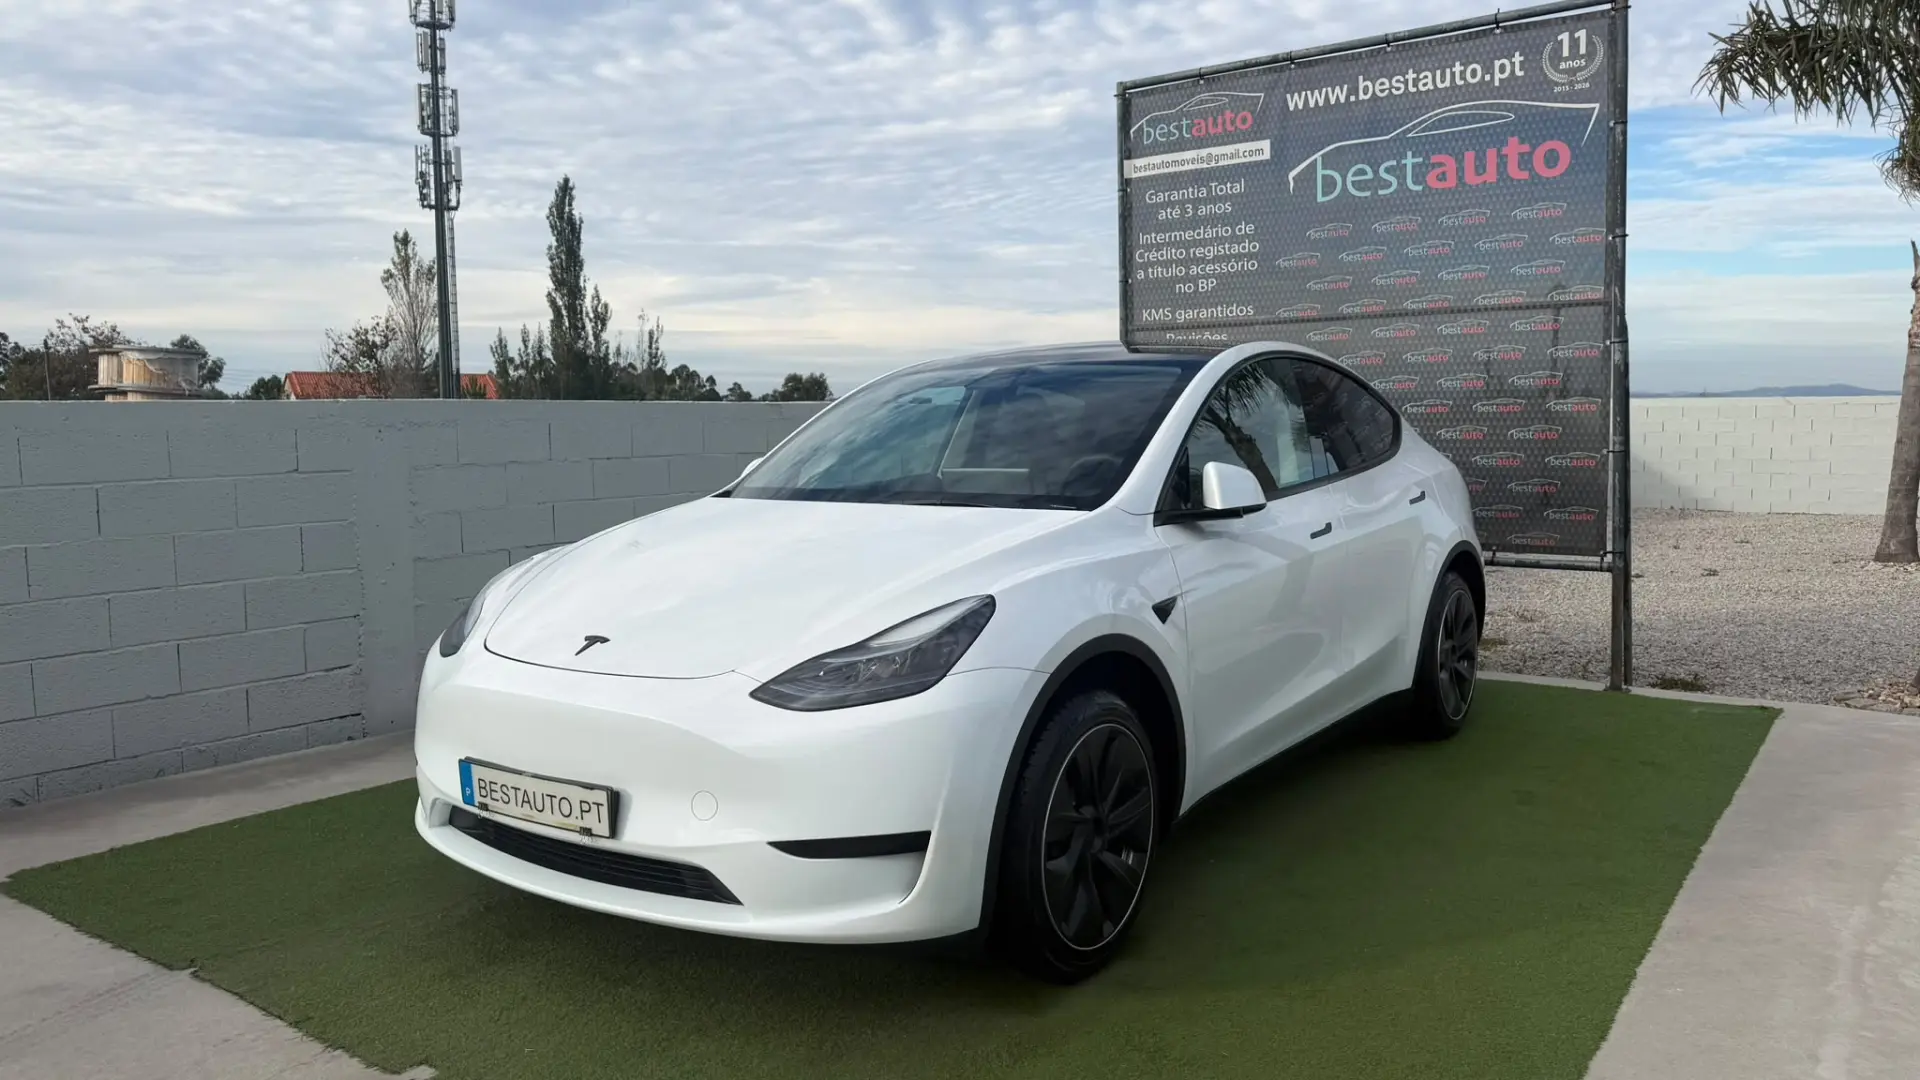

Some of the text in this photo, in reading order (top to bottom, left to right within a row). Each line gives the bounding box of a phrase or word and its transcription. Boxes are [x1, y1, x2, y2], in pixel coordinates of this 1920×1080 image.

[1557, 29, 1587, 57] 11
[1560, 59, 1586, 69] anos
[1286, 51, 1525, 111] www.bestauto.pt
[1143, 110, 1254, 144] bestauto
[1133, 146, 1264, 174] bestautomoveis@gmail.com
[1316, 136, 1572, 202] bestauto
[1145, 178, 1245, 204] Garantia Total
[1158, 202, 1232, 221] até 3 anos
[1516, 209, 1562, 219] bestauto
[1443, 216, 1486, 226] bestauto
[1376, 222, 1417, 233] bestauto
[1139, 221, 1255, 245] Intermedário de
[1310, 230, 1348, 239] bestauto
[1555, 234, 1602, 245] bestauto
[1480, 240, 1524, 250] bestauto
[1135, 240, 1260, 263] Crédito registado
[1409, 246, 1450, 256] bestauto
[1343, 252, 1382, 262] bestauto
[1280, 258, 1317, 268] bestauto
[1136, 257, 1258, 280] a título acessório
[1516, 265, 1561, 276] bestauto
[1376, 276, 1416, 286] bestauto
[1443, 271, 1486, 281] bestauto
[1175, 279, 1217, 293] no BP
[1310, 282, 1349, 291] bestauto
[1479, 296, 1522, 305] bestauto
[1553, 291, 1600, 301] bestauto
[1343, 304, 1383, 314] bestauto
[1408, 300, 1449, 309] bestauto
[1142, 303, 1254, 322] KMS garantidos
[1280, 309, 1317, 318] bestauto
[1442, 326, 1485, 335] bestauto
[1515, 321, 1560, 331] bestauto
[1311, 332, 1349, 341] bestauto
[1376, 329, 1416, 338] bestauto
[1408, 353, 1448, 362] bestauto
[1478, 351, 1522, 360] bestauto
[1553, 348, 1598, 357] bestauto
[1343, 357, 1382, 366] bestauto
[1375, 381, 1416, 390] bestauto
[1442, 379, 1484, 388] bestauto
[1515, 376, 1559, 386] bestauto
[1407, 405, 1448, 414] bestauto
[1478, 404, 1520, 412] bestauto
[1551, 402, 1597, 411] bestauto
[1441, 431, 1484, 440] bestauto
[1513, 430, 1558, 439] bestauto
[1477, 457, 1520, 466] bestauto
[1550, 456, 1596, 466] bestauto
[478, 778, 604, 824] BESTAUTO.PT
